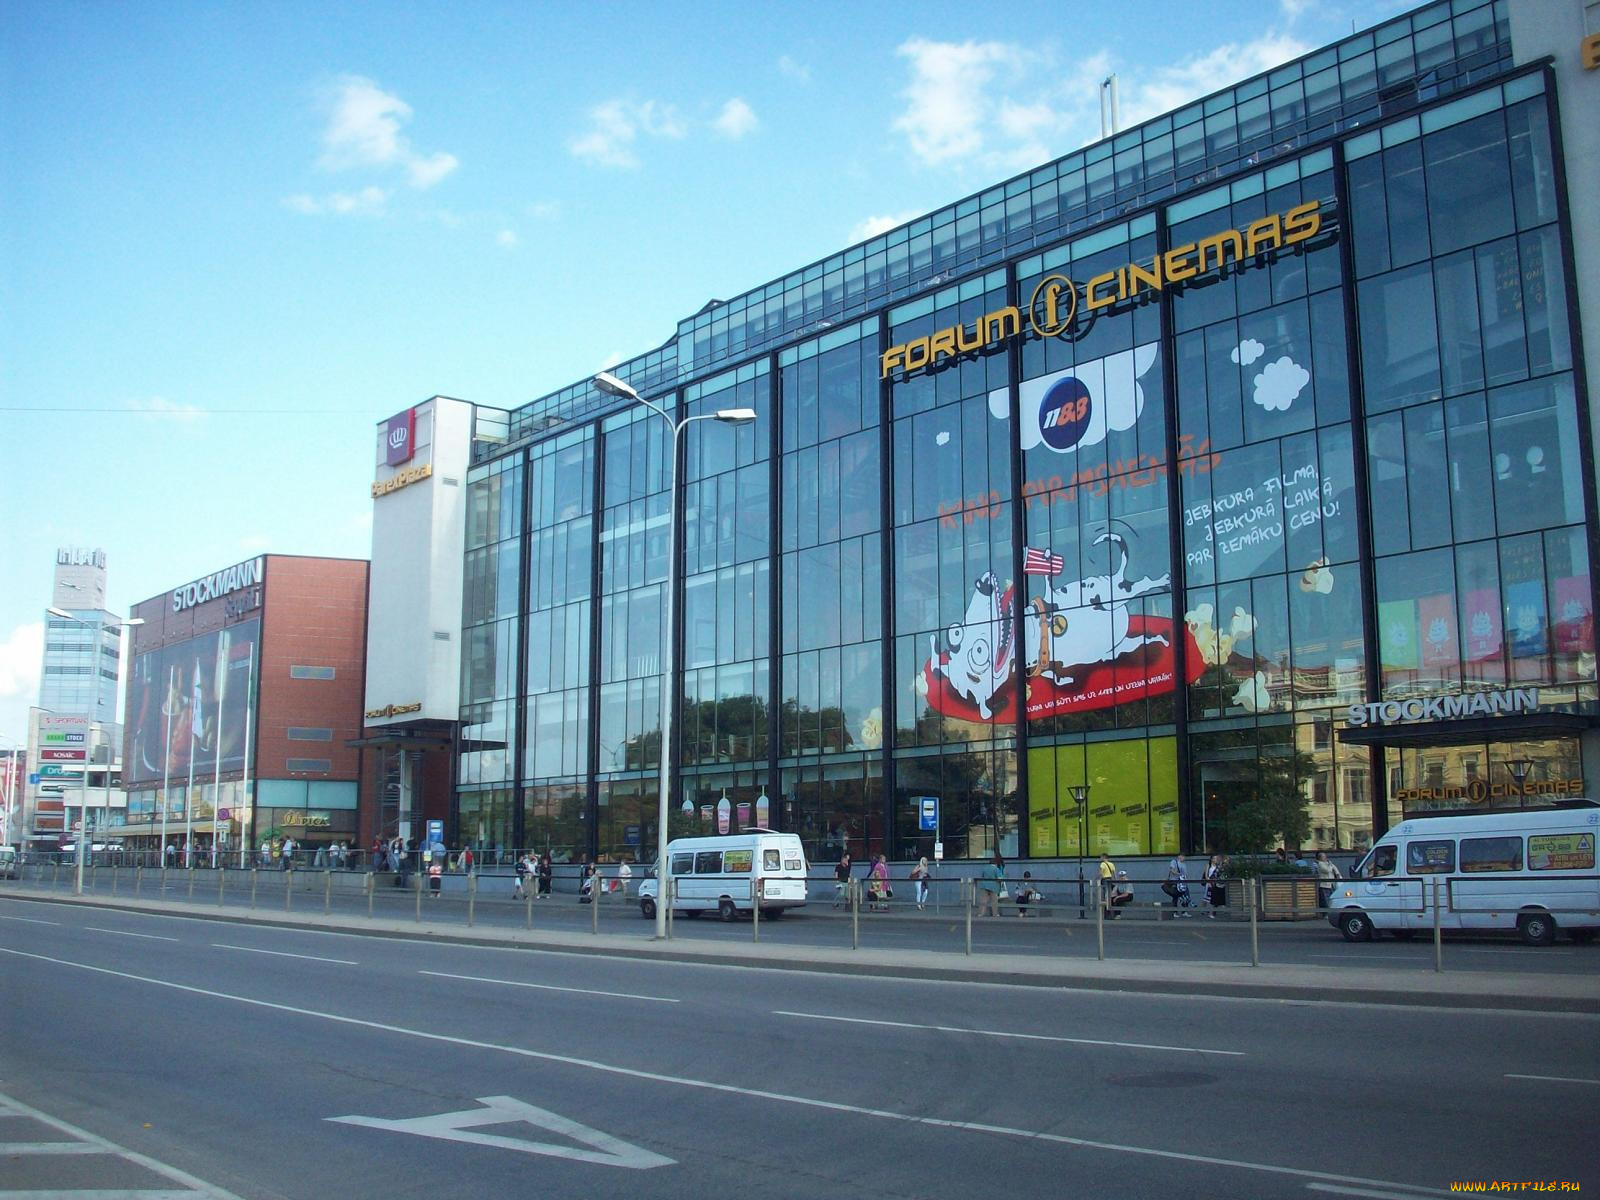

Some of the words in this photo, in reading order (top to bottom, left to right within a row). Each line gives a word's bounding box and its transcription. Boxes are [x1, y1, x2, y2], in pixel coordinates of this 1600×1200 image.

[882, 305, 1021, 378] FORUM
[1086, 200, 1323, 311] CINEMAS
[938, 490, 1001, 529] KINO
[1184, 487, 1254, 526] JEBKURA
[1204, 498, 1275, 541] JEBKURĀ
[1284, 477, 1333, 509] LAIKĀ
[1187, 548, 1213, 566] PAR
[1219, 522, 1282, 554] ZEMĀKU
[1290, 501, 1341, 530] CENU!
[172, 556, 264, 612] STOCKMANN
[1349, 687, 1539, 725] STOCKMANN
[1396, 787, 1465, 801] FORUM
[1489, 779, 1584, 797] CINEMAS
